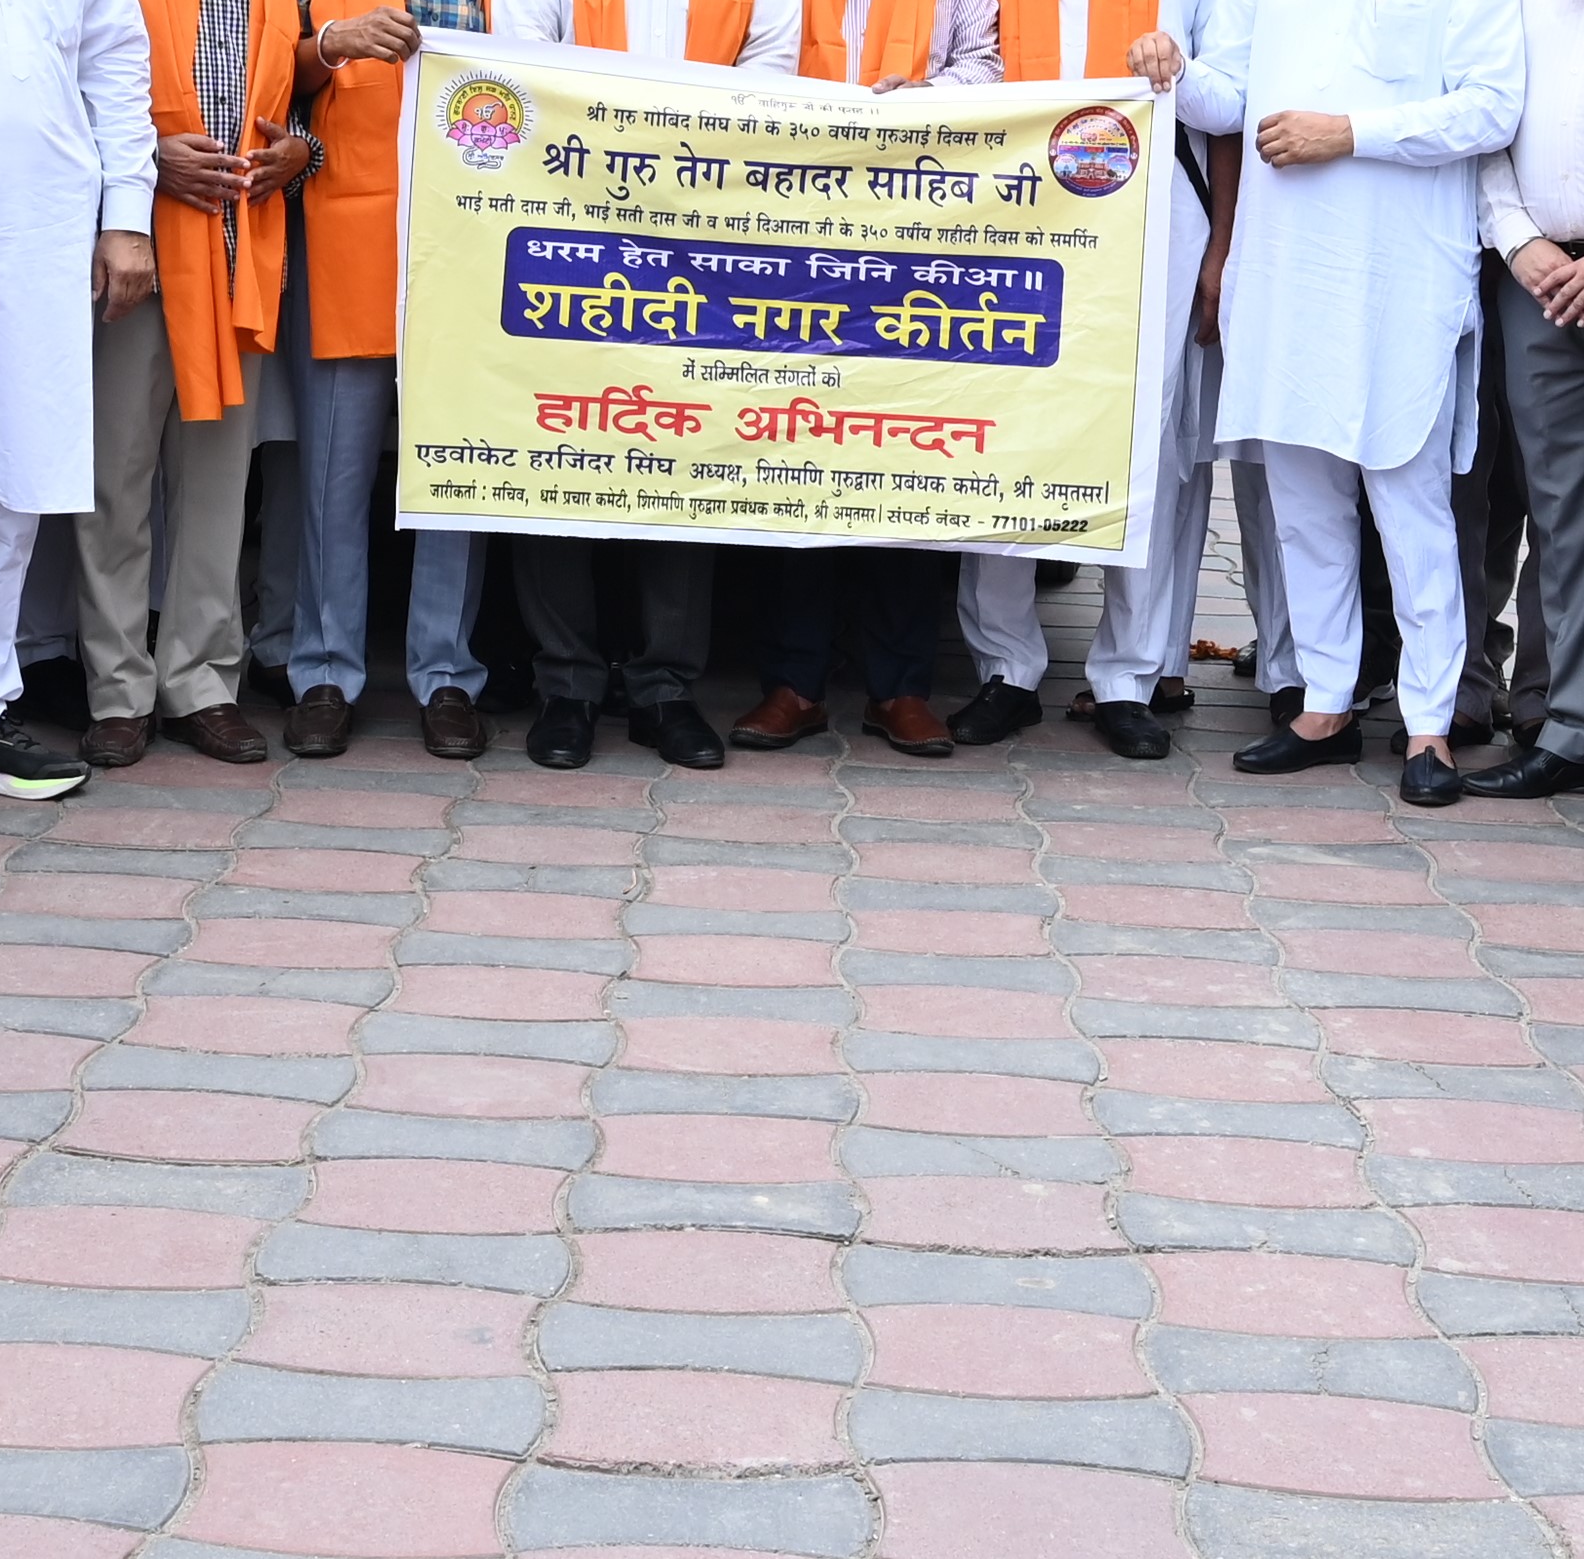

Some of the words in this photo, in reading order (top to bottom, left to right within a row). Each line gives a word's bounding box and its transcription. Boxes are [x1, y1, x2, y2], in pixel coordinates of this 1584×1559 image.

[587, 102, 608, 122] श्री
[614, 108, 638, 133] गुरु
[644, 106, 692, 131] गोबिंद
[698, 110, 731, 132] सिंघ
[738, 114, 758, 135] जी
[764, 115, 782, 136] के
[789, 122, 820, 140] ३५०
[828, 121, 870, 142] वर्षीय
[876, 124, 932, 150] गुरुआई
[937, 124, 978, 146] दिवस
[984, 128, 1008, 150] एवं
[542, 134, 591, 179] श्री
[604, 150, 661, 201] गुरु
[674, 141, 731, 190] तेग
[744, 160, 854, 201] बहादर
[866, 155, 980, 208] साहिब
[992, 162, 1044, 208] जी
[456, 190, 483, 214] भाई
[488, 194, 515, 214] मती
[520, 199, 548, 216] दास
[552, 197, 576, 222] जी,
[584, 200, 611, 224] भाई
[616, 204, 644, 224] सती
[649, 210, 677, 227] दास
[682, 210, 702, 228] जी
[706, 216, 718, 230] व
[724, 212, 750, 236] भाई
[756, 212, 810, 236] दिआला
[816, 216, 834, 236] जी
[839, 217, 854, 238] के
[860, 224, 888, 242] ३५०
[894, 222, 932, 242] वर्षीय
[937, 224, 978, 245] शहीदी
[984, 224, 1020, 246] दिवस
[1025, 226, 1044, 246] को
[1050, 228, 1098, 249] समर्पित
[527, 240, 604, 263] धरम
[619, 238, 674, 269] हेत
[688, 252, 792, 276] साका
[806, 252, 898, 283] जिनि
[518, 271, 708, 340] शहीदी
[728, 296, 850, 346] नगर
[870, 290, 1047, 356] कीर्तन
[682, 357, 696, 380] में
[700, 360, 770, 384] सम्मिलित
[774, 364, 818, 386] संगतों
[821, 365, 842, 388] को
[534, 383, 712, 442] हार्दिक
[734, 396, 996, 458] अभिनन्दन
[414, 438, 518, 468] एडवोकेट
[527, 444, 616, 474] हरजिंदर
[624, 448, 676, 476] सिंघ
[689, 460, 748, 488] अध्यक्ष,
[756, 458, 824, 486] शिरोमणि
[830, 470, 885, 497] गुरुद्वारा
[891, 470, 946, 493] प्रबंधक
[952, 470, 1004, 503] कमेटी,
[1014, 475, 1035, 500] श्री
[430, 478, 477, 500] जारीकर्ता
[492, 480, 530, 507] सचिव,
[540, 484, 558, 504] धर्म
[562, 490, 592, 507] प्रचार
[596, 486, 632, 513] कमेटी,
[637, 488, 684, 512] शिरोमणि
[688, 498, 726, 520] गुरुद्वारा
[730, 497, 769, 516] प्रबंधक
[773, 497, 808, 523] कमेटी,
[814, 499, 828, 520] श्री
[887, 505, 932, 526] संपर्क
[936, 508, 972, 529] नंबर
[991, 514, 1089, 534] 77101-05222
